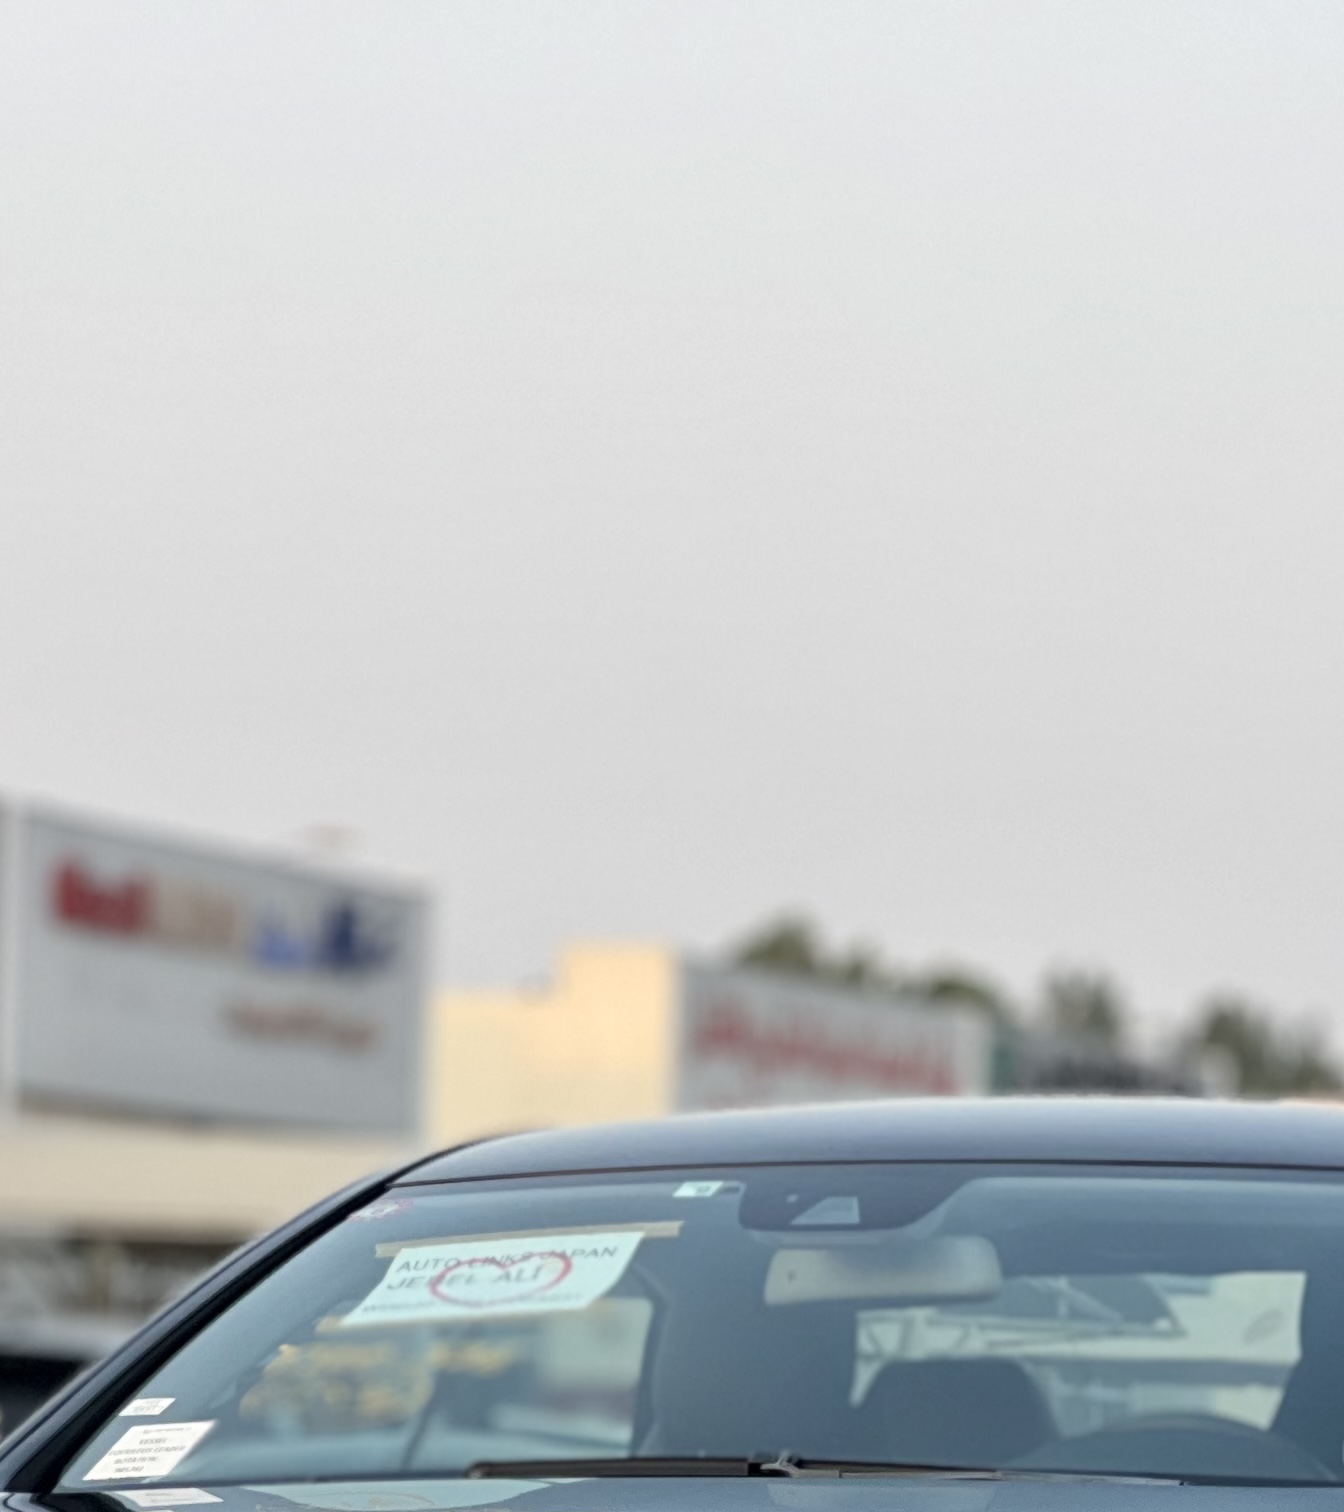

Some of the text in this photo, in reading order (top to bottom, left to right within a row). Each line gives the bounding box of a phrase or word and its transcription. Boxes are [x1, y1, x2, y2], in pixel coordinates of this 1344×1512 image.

[396, 1257, 460, 1273] AUTO
[541, 1246, 618, 1261] JAPAN
[493, 1266, 544, 1284] ALI
